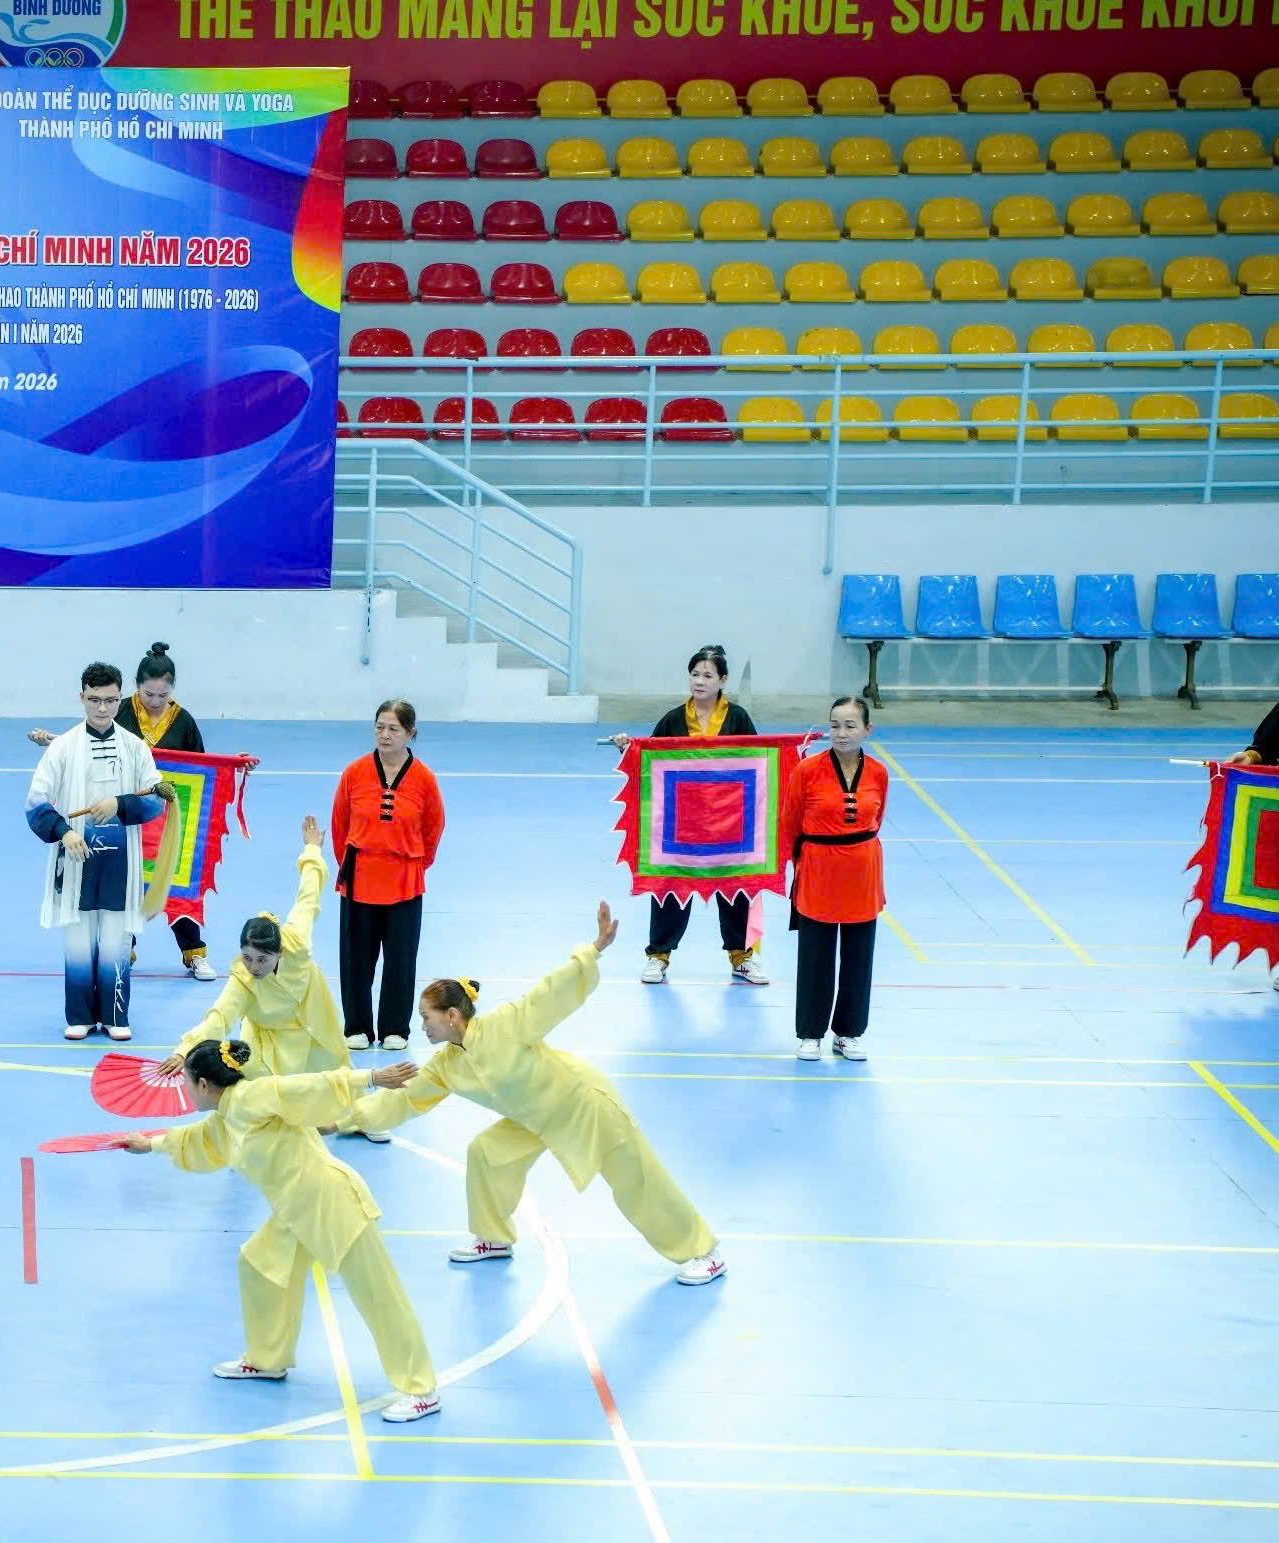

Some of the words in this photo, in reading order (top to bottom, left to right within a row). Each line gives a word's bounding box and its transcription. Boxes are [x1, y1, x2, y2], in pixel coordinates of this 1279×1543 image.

[272, 0, 383, 39] THAO
[398, 0, 533, 39] MANG
[549, 0, 619, 49] LẠI
[42, 84, 74, 111] THỂ
[78, 92, 111, 115] DỤC
[117, 87, 173, 112] DƯỠNG
[179, 92, 219, 113] SINH
[225, 89, 246, 113] VÀ
[251, 93, 294, 113] YOGA
[18, 116, 73, 139] THÀNH
[79, 115, 113, 139] PHỐ
[117, 115, 139, 139] HỒ
[146, 116, 173, 140] CHÍ
[178, 120, 223, 140] MINH
[45, 236, 112, 266] MINH
[118, 231, 181, 266] NĂM
[186, 237, 251, 267] 2026
[26, 282, 65, 309] THÀNH
[69, 280, 95, 309] PHỐ
[98, 280, 113, 309] HỒ
[118, 284, 138, 309] CHÍ
[142, 288, 174, 310] MINH
[178, 288, 212, 312] (1976
[224, 288, 259, 312] 2026)
[13, 323, 17, 344] I
[20, 318, 50, 344] NĂM
[53, 323, 82, 344] 2026
[14, 374, 58, 391] 2026
